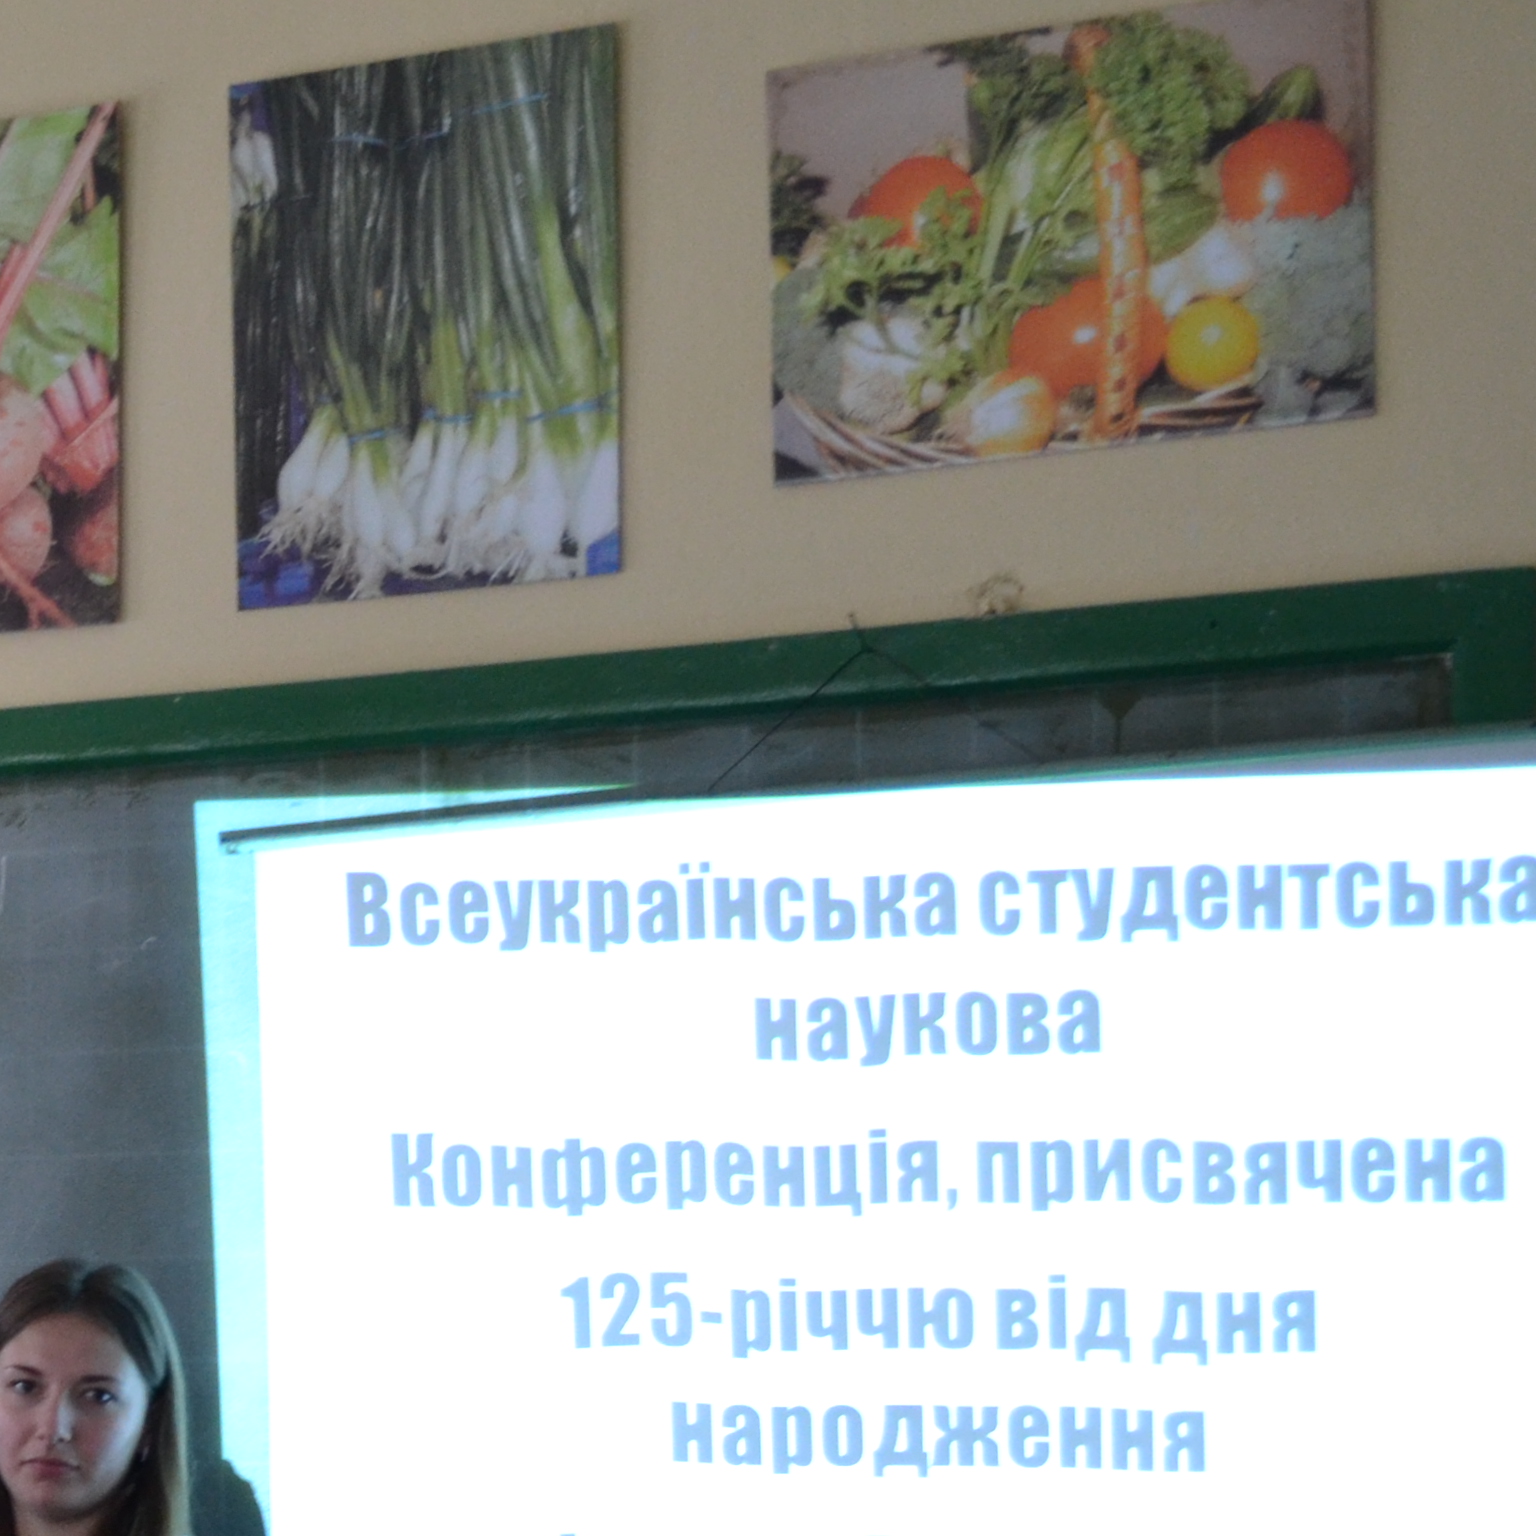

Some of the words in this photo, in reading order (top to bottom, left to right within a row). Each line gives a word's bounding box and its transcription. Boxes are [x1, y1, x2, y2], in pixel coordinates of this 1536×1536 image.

[347, 863, 958, 953] Всеукраїнська
[980, 856, 1536, 944] студентська
[756, 991, 1102, 1068] наукова
[978, 1138, 1507, 1212] присвячена
[562, 1273, 975, 1359] 125-річчю
[997, 1276, 1132, 1364] від
[1154, 1291, 1317, 1367] дня
[673, 1403, 1207, 1478] народження
